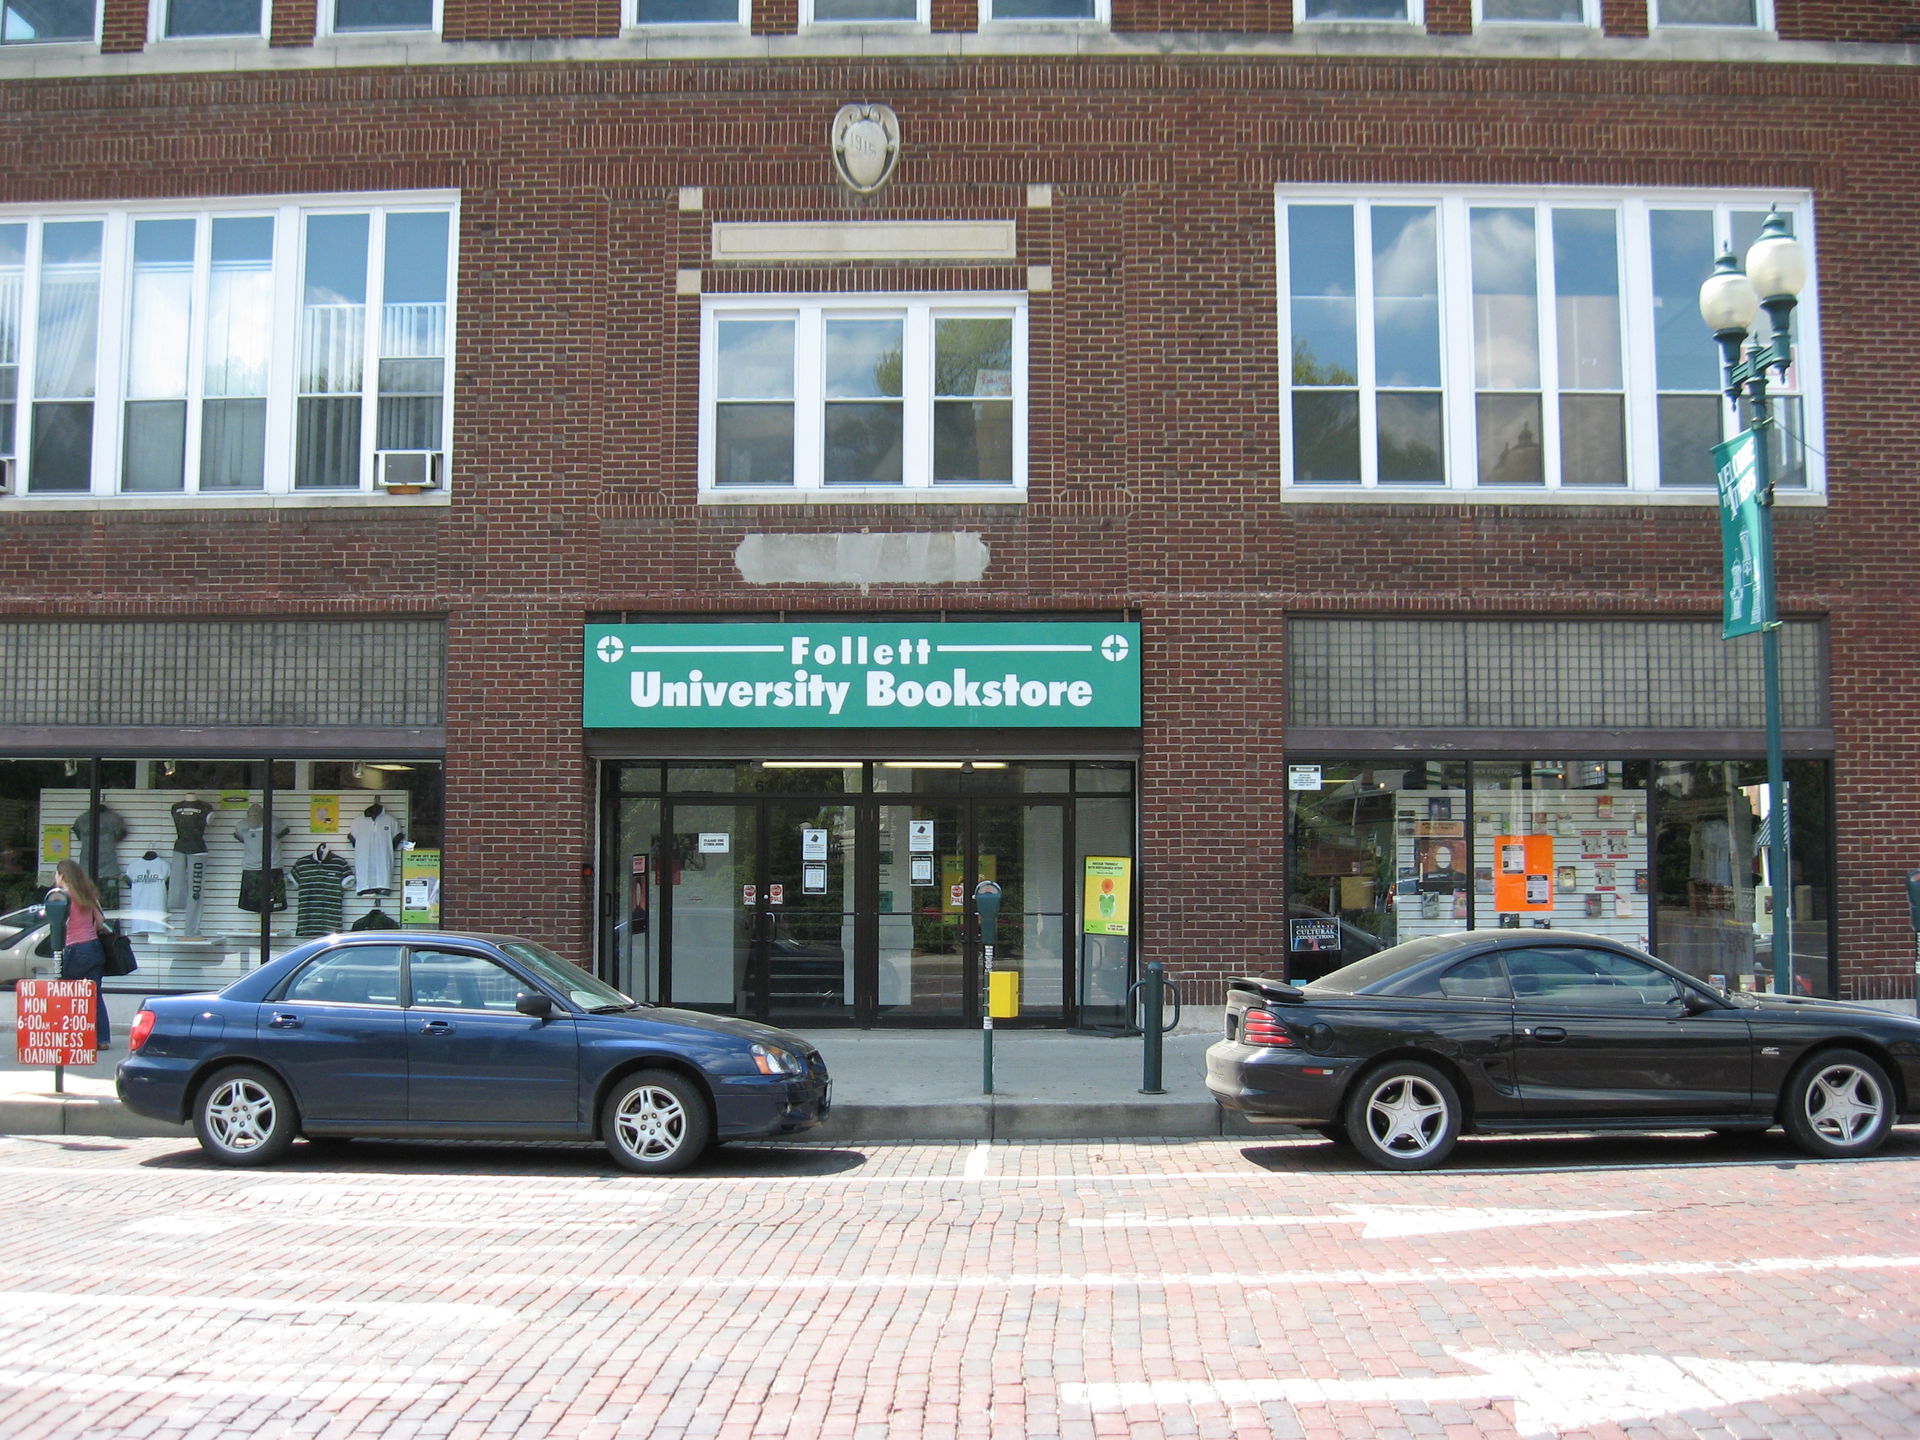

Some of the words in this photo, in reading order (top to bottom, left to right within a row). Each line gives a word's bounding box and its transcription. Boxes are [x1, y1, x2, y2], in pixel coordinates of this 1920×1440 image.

[850, 132, 877, 158] 1915
[791, 636, 931, 665] Follett
[630, 669, 851, 714] University
[866, 668, 1093, 707] Bookstore
[21, 981, 36, 997] NO
[47, 981, 92, 997] PARKING
[24, 998, 47, 1013] MON
[71, 999, 89, 1014] FRI
[29, 1031, 84, 1047] BUSINESS
[19, 1048, 62, 1063] LOADING
[69, 1049, 96, 1064] ZONE
